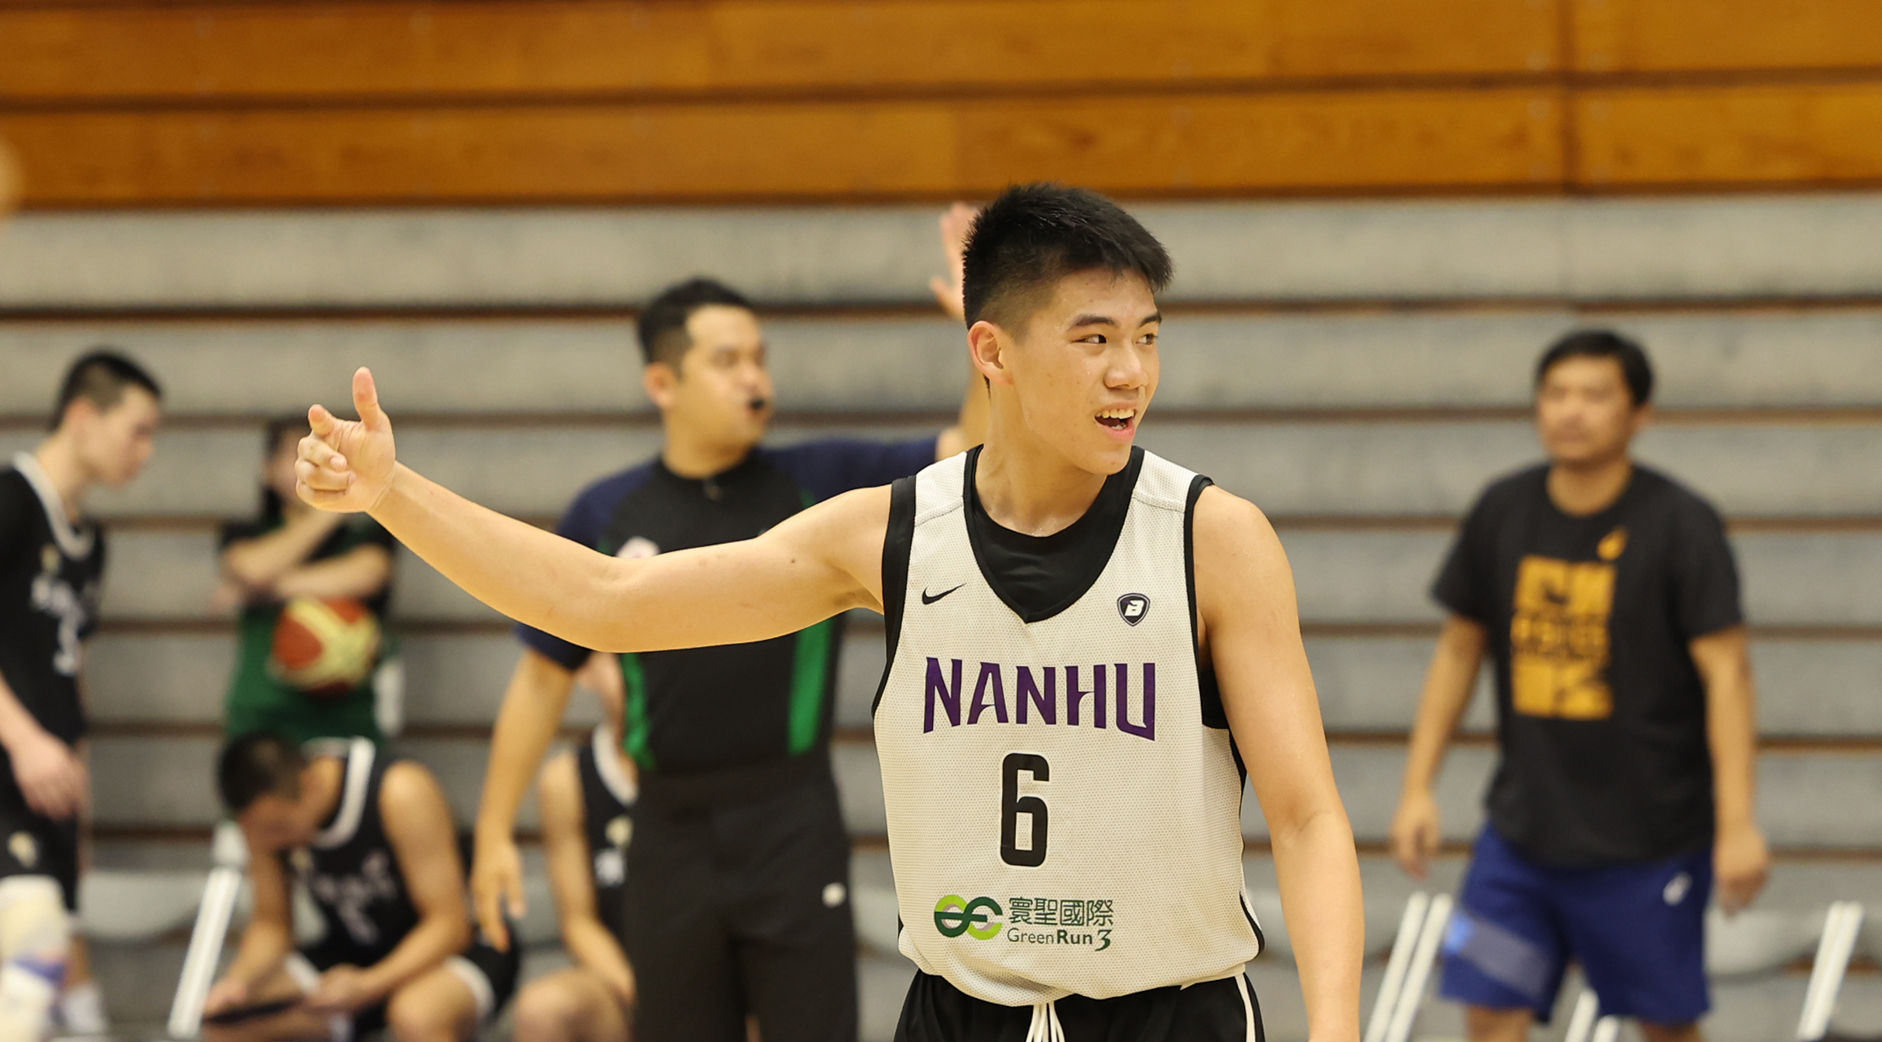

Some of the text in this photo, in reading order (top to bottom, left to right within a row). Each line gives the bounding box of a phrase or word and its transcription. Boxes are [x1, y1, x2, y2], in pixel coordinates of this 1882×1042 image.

[923, 657, 1156, 741] NANHU
[1000, 752, 1050, 868] 6
[1008, 896, 1114, 927] 寰聖國際
